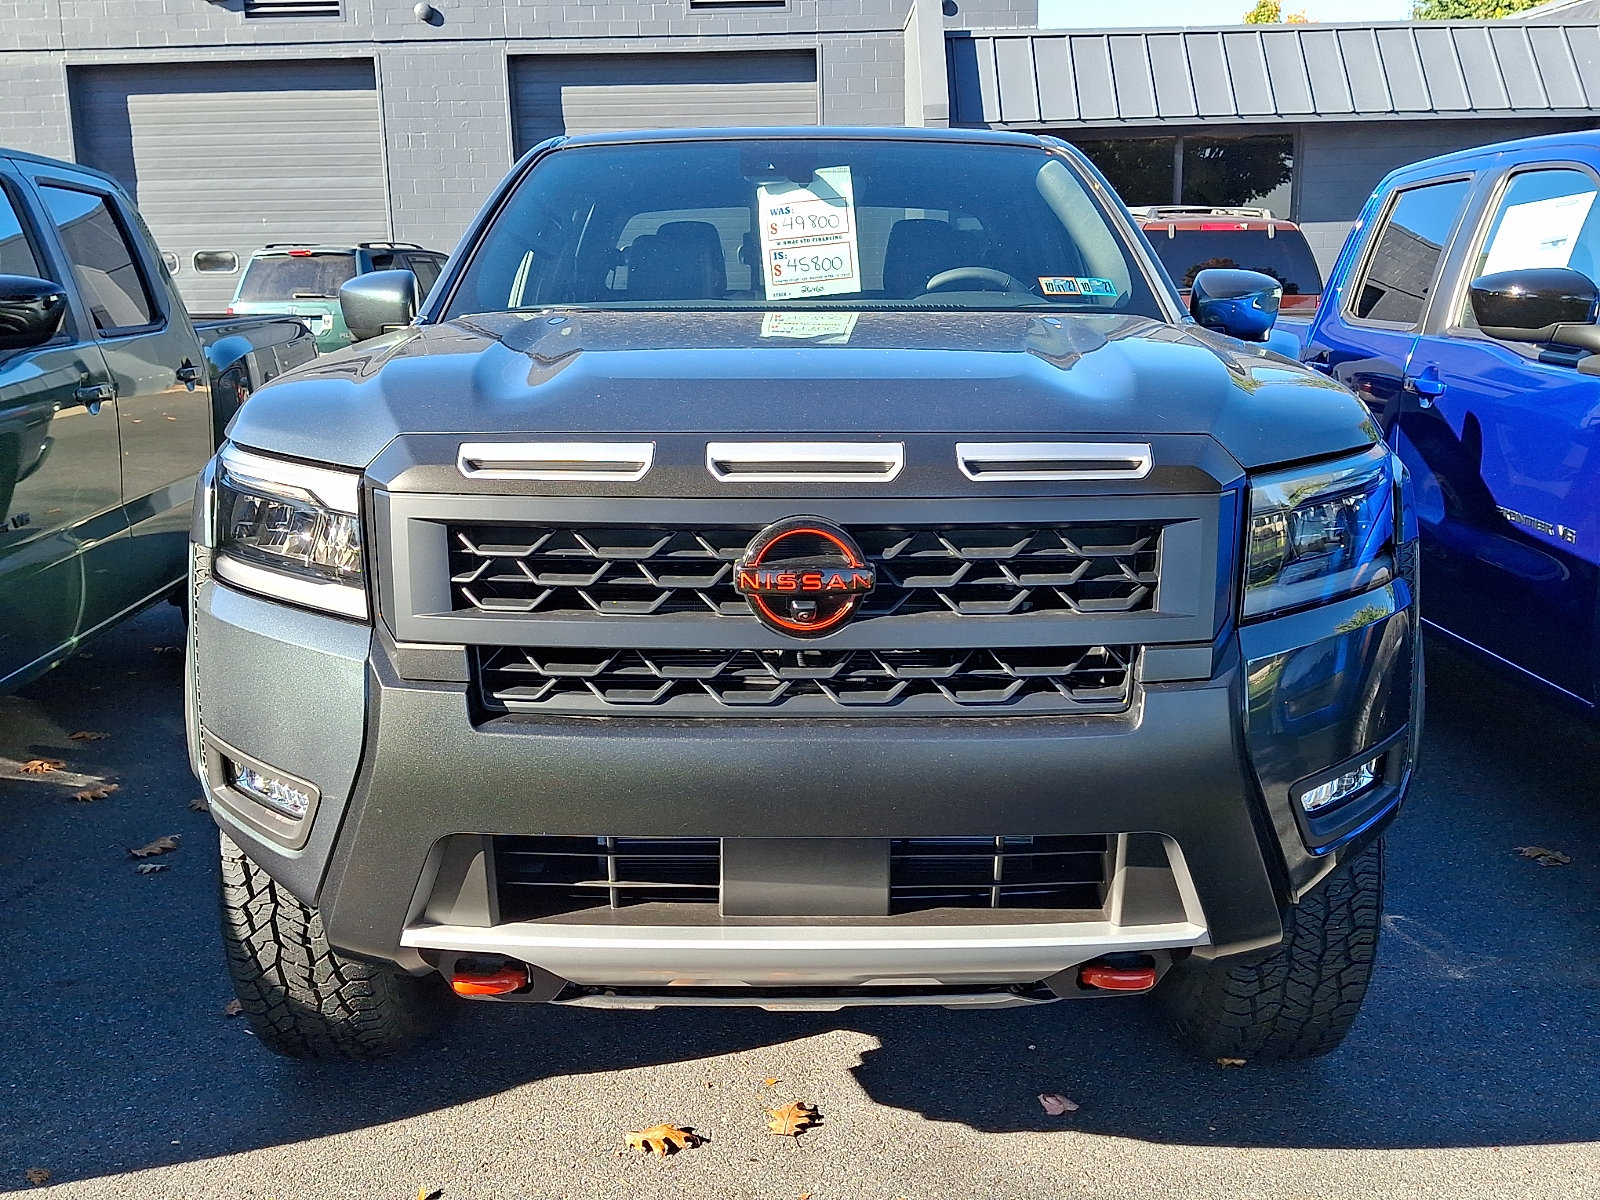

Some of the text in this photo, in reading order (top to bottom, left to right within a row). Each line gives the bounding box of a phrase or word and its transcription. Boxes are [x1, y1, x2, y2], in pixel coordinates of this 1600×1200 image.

[769, 206, 795, 216] WAS:
[782, 214, 840, 230] 49800
[812, 235, 843, 243] FINANCING
[773, 251, 788, 260] IS:
[786, 255, 843, 272] 45800
[1556, 524, 1577, 544] V6
[739, 571, 872, 591] NISSAN
